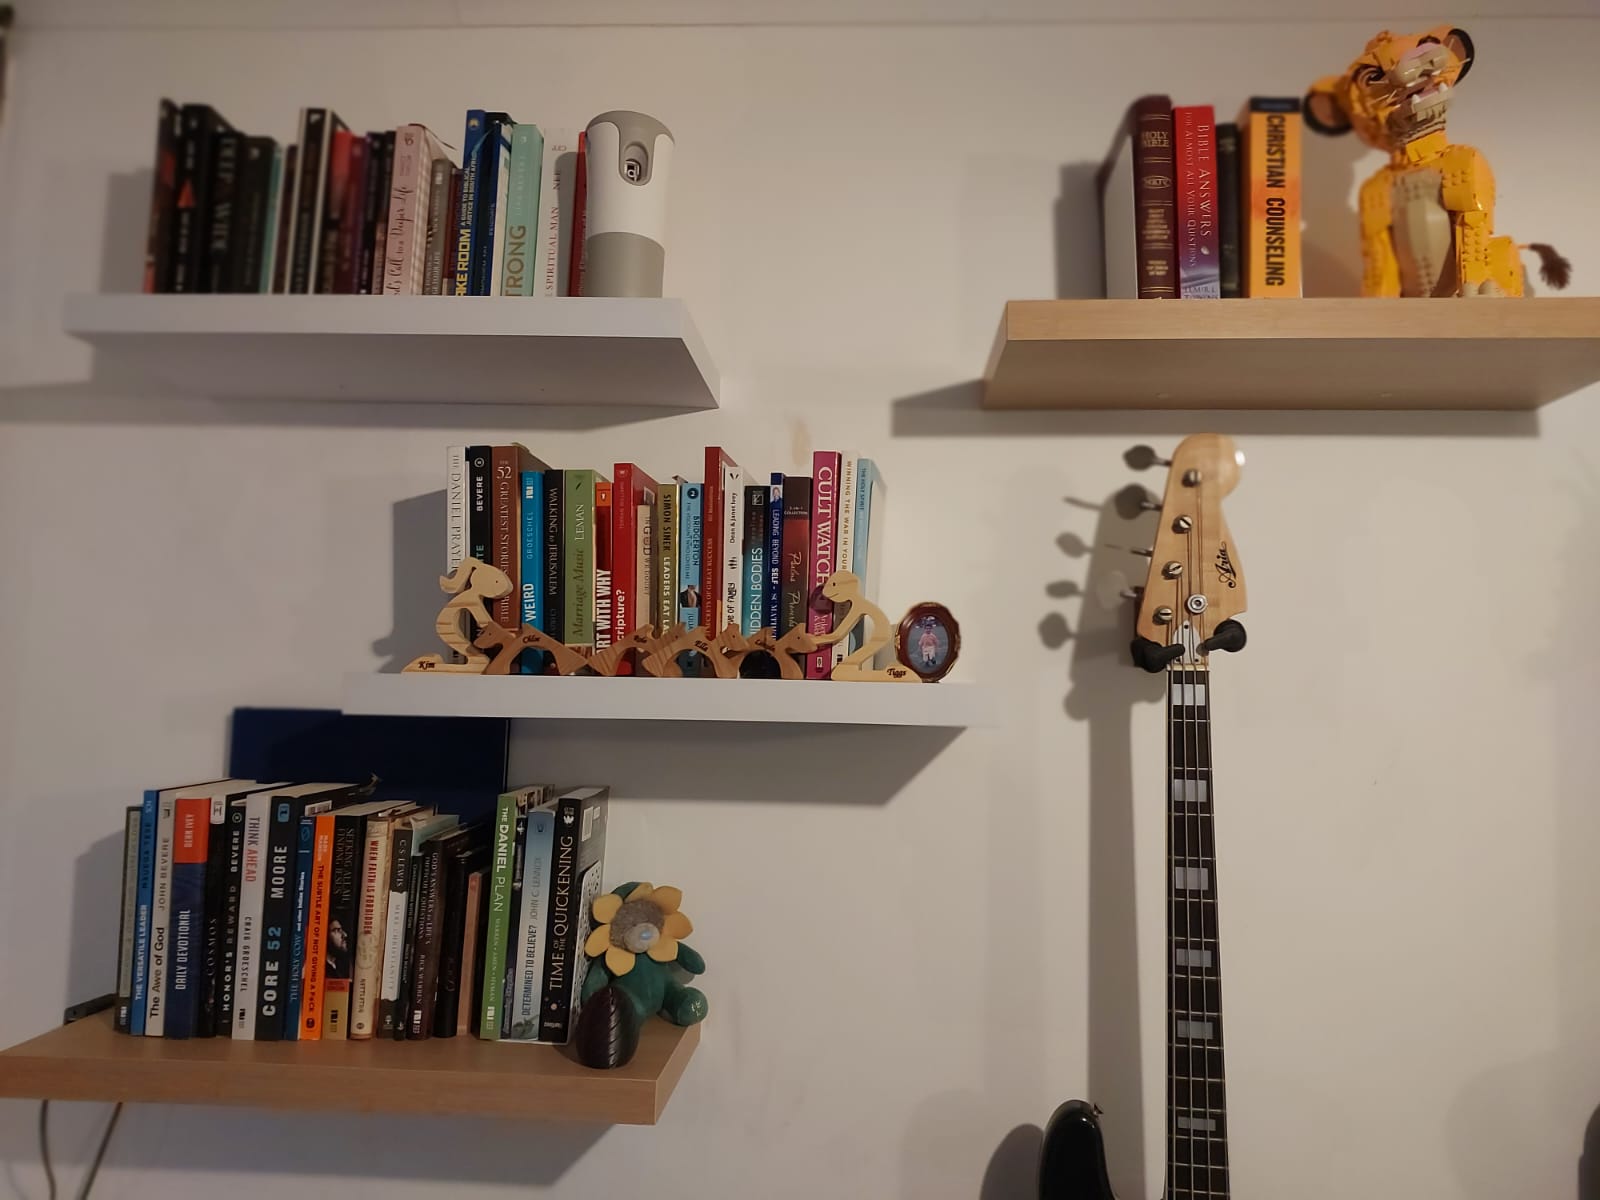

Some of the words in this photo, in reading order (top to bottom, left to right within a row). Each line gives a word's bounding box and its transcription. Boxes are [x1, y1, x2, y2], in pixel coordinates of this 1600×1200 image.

[1184, 130, 1194, 167] ALMOST
[1196, 125, 1210, 162] BIBLE
[1266, 114, 1286, 189] CHRISTIAN
[390, 185, 413, 204] Life
[463, 193, 469, 201] TO
[1186, 189, 1197, 216] YOUR
[1198, 168, 1212, 238] ANSWERS
[389, 206, 414, 237] Deeper
[550, 207, 560, 231] MAN
[457, 229, 472, 272] ROOM
[1187, 219, 1199, 267] QUESTIONS
[1265, 197, 1286, 287] COUNSELING
[546, 234, 558, 290] SPIRITUAL
[497, 466, 512, 479] 52
[844, 460, 852, 496] WINNING
[451, 473, 462, 520] DANIEL
[476, 475, 485, 512] BEVERE
[500, 482, 510, 532] GREATEST
[662, 494, 672, 523] SIMON
[817, 466, 834, 521] CULT
[843, 498, 851, 514] THE
[548, 487, 558, 533] WALKING
[574, 503, 585, 541] LEMAN
[771, 509, 780, 536] LEADING
[526, 512, 534, 560] GROESCHEL
[662, 526, 671, 551] SINEK
[692, 515, 700, 566] BRIDGERTON
[842, 517, 850, 535] WAR
[842, 537, 849, 546] IN
[572, 549, 584, 582] Music
[771, 539, 780, 564] BEYOND
[841, 548, 849, 571] YOUR
[548, 543, 559, 595] JERUSALEM
[596, 569, 611, 597] WHY
[662, 556, 672, 597] LEADERS
[751, 547, 763, 590] BODIES
[771, 567, 780, 585] SELF
[522, 583, 537, 621] WEIRD
[572, 584, 587, 637] Marriage
[596, 599, 612, 629] WITH
[661, 599, 671, 617] EAT
[418, 661, 435, 670] Kim
[501, 807, 509, 823] THE
[246, 817, 261, 846] THINK
[160, 836, 170, 878] BEVERE
[230, 830, 241, 873] BEVERE
[344, 828, 355, 867] SEEKING
[368, 840, 380, 861] WHEN
[496, 824, 511, 873] DANIEL
[245, 849, 259, 882] AHEAD
[269, 844, 288, 899] MOORE
[317, 865, 325, 879] THE
[366, 863, 378, 883] FAITH
[397, 857, 407, 887] LEWIS
[421, 856, 431, 895] DIFFICULT
[430, 852, 439, 877] GOD'S
[531, 857, 543, 888] LENNOX
[158, 883, 167, 911] JOHN
[314, 881, 324, 908] SUBTLE
[365, 884, 375, 893] IS
[427, 878, 437, 913] ANSWERS
[493, 876, 507, 913] PLAN
[553, 835, 574, 937] QUICKENING
[140, 904, 148, 938] LEADER
[226, 885, 238, 944] REWARD
[313, 911, 322, 925] ART
[363, 895, 375, 935] FORBIDDEN
[418, 896, 428, 940] QUESTIONS
[528, 898, 539, 920] JOHN
[154, 928, 166, 951] God
[176, 908, 192, 963] DEVOTIONAL
[242, 916, 253, 942] CRAIG
[266, 926, 281, 951] 52
[312, 927, 321, 937] OF
[425, 922, 434, 945] LIFE'S
[526, 924, 538, 959] BELIEVE?
[137, 938, 146, 983] VERSATILE
[153, 953, 163, 966] of
[293, 934, 302, 957] COW
[310, 939, 320, 955] NOT
[174, 965, 188, 990] DAILY
[239, 945, 252, 993] GROESCHEL
[291, 957, 301, 981] HOLY
[309, 957, 318, 982] GIVING
[418, 953, 427, 972] RICK
[525, 959, 535, 968] TO
[549, 952, 565, 991] TIME
[134, 983, 144, 1001] THE
[151, 969, 162, 993] Awe
[222, 950, 234, 1011] HONOR'S
[261, 960, 280, 1017] CORE
[290, 982, 299, 1001] THE
[415, 972, 424, 1004] WARREN
[521, 970, 534, 1016] DETERMINED
[149, 996, 161, 1018] The
